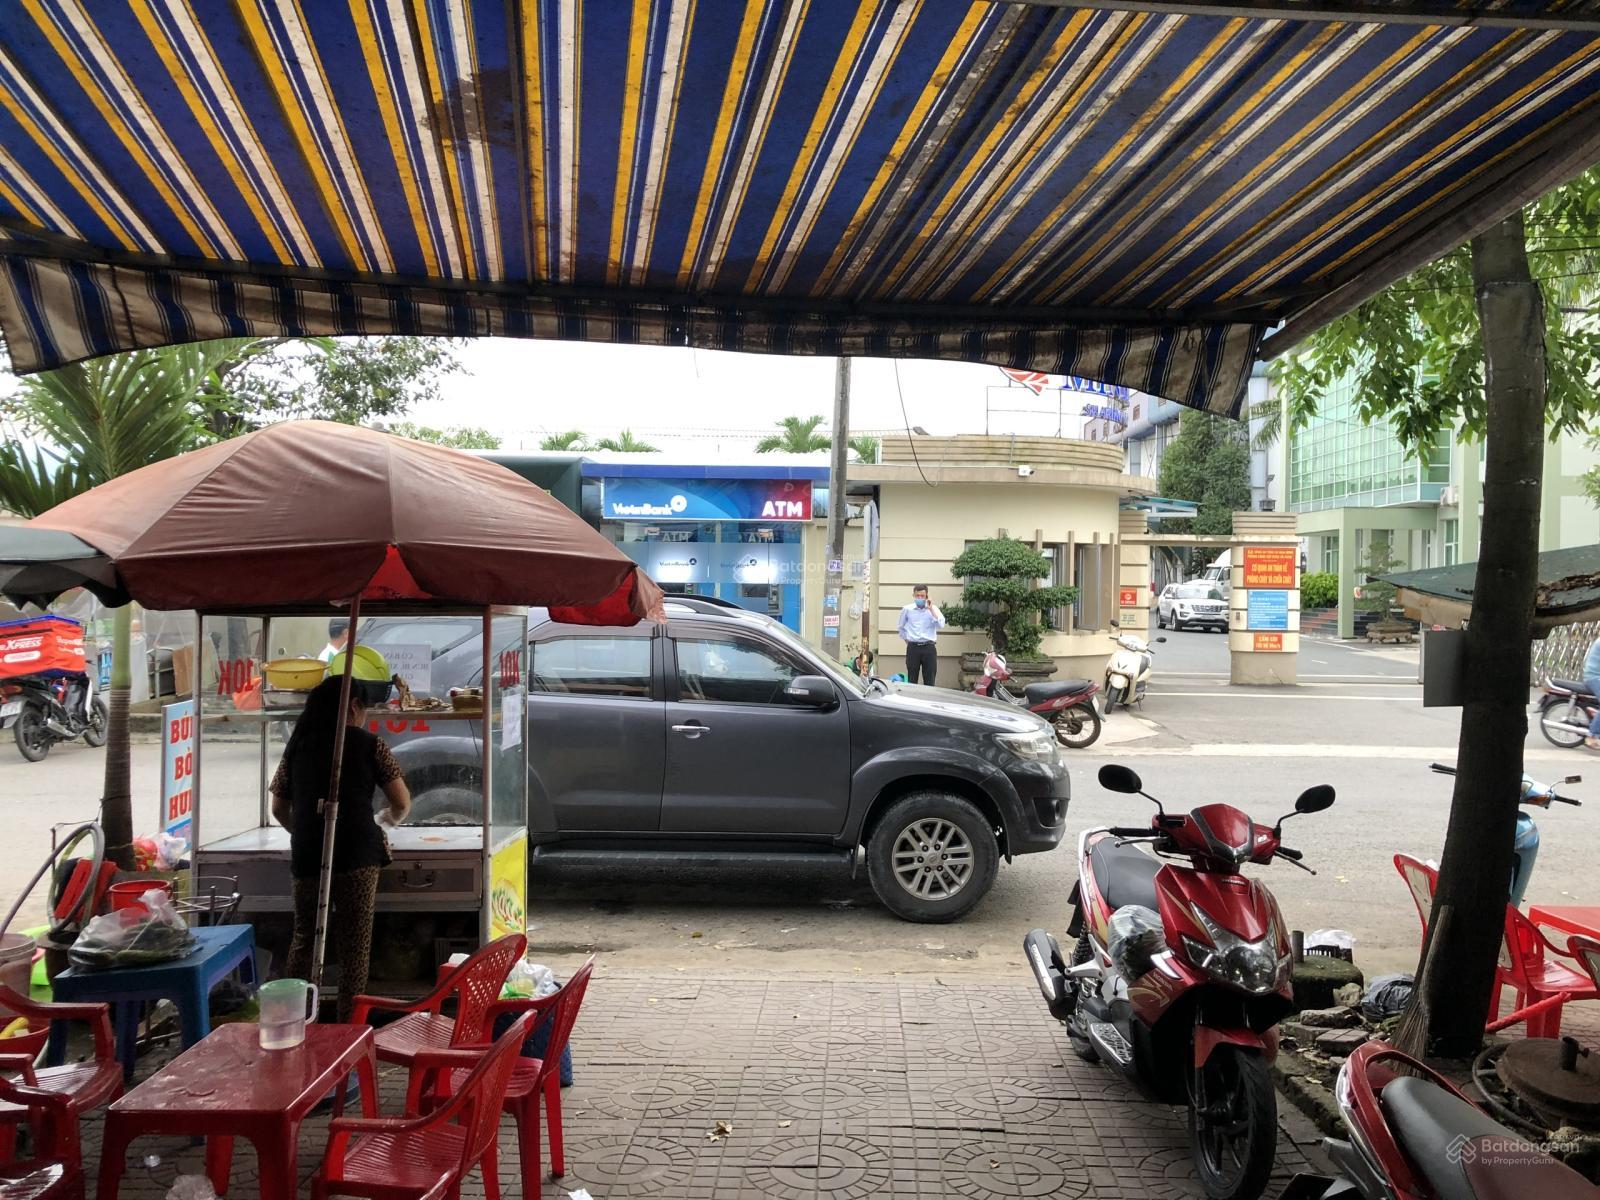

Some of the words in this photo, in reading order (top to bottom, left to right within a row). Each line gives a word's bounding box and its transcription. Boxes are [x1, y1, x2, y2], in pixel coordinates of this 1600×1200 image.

[612, 502, 673, 516] VietinBank
[761, 501, 803, 517] ATM
[662, 532, 690, 543] ATM
